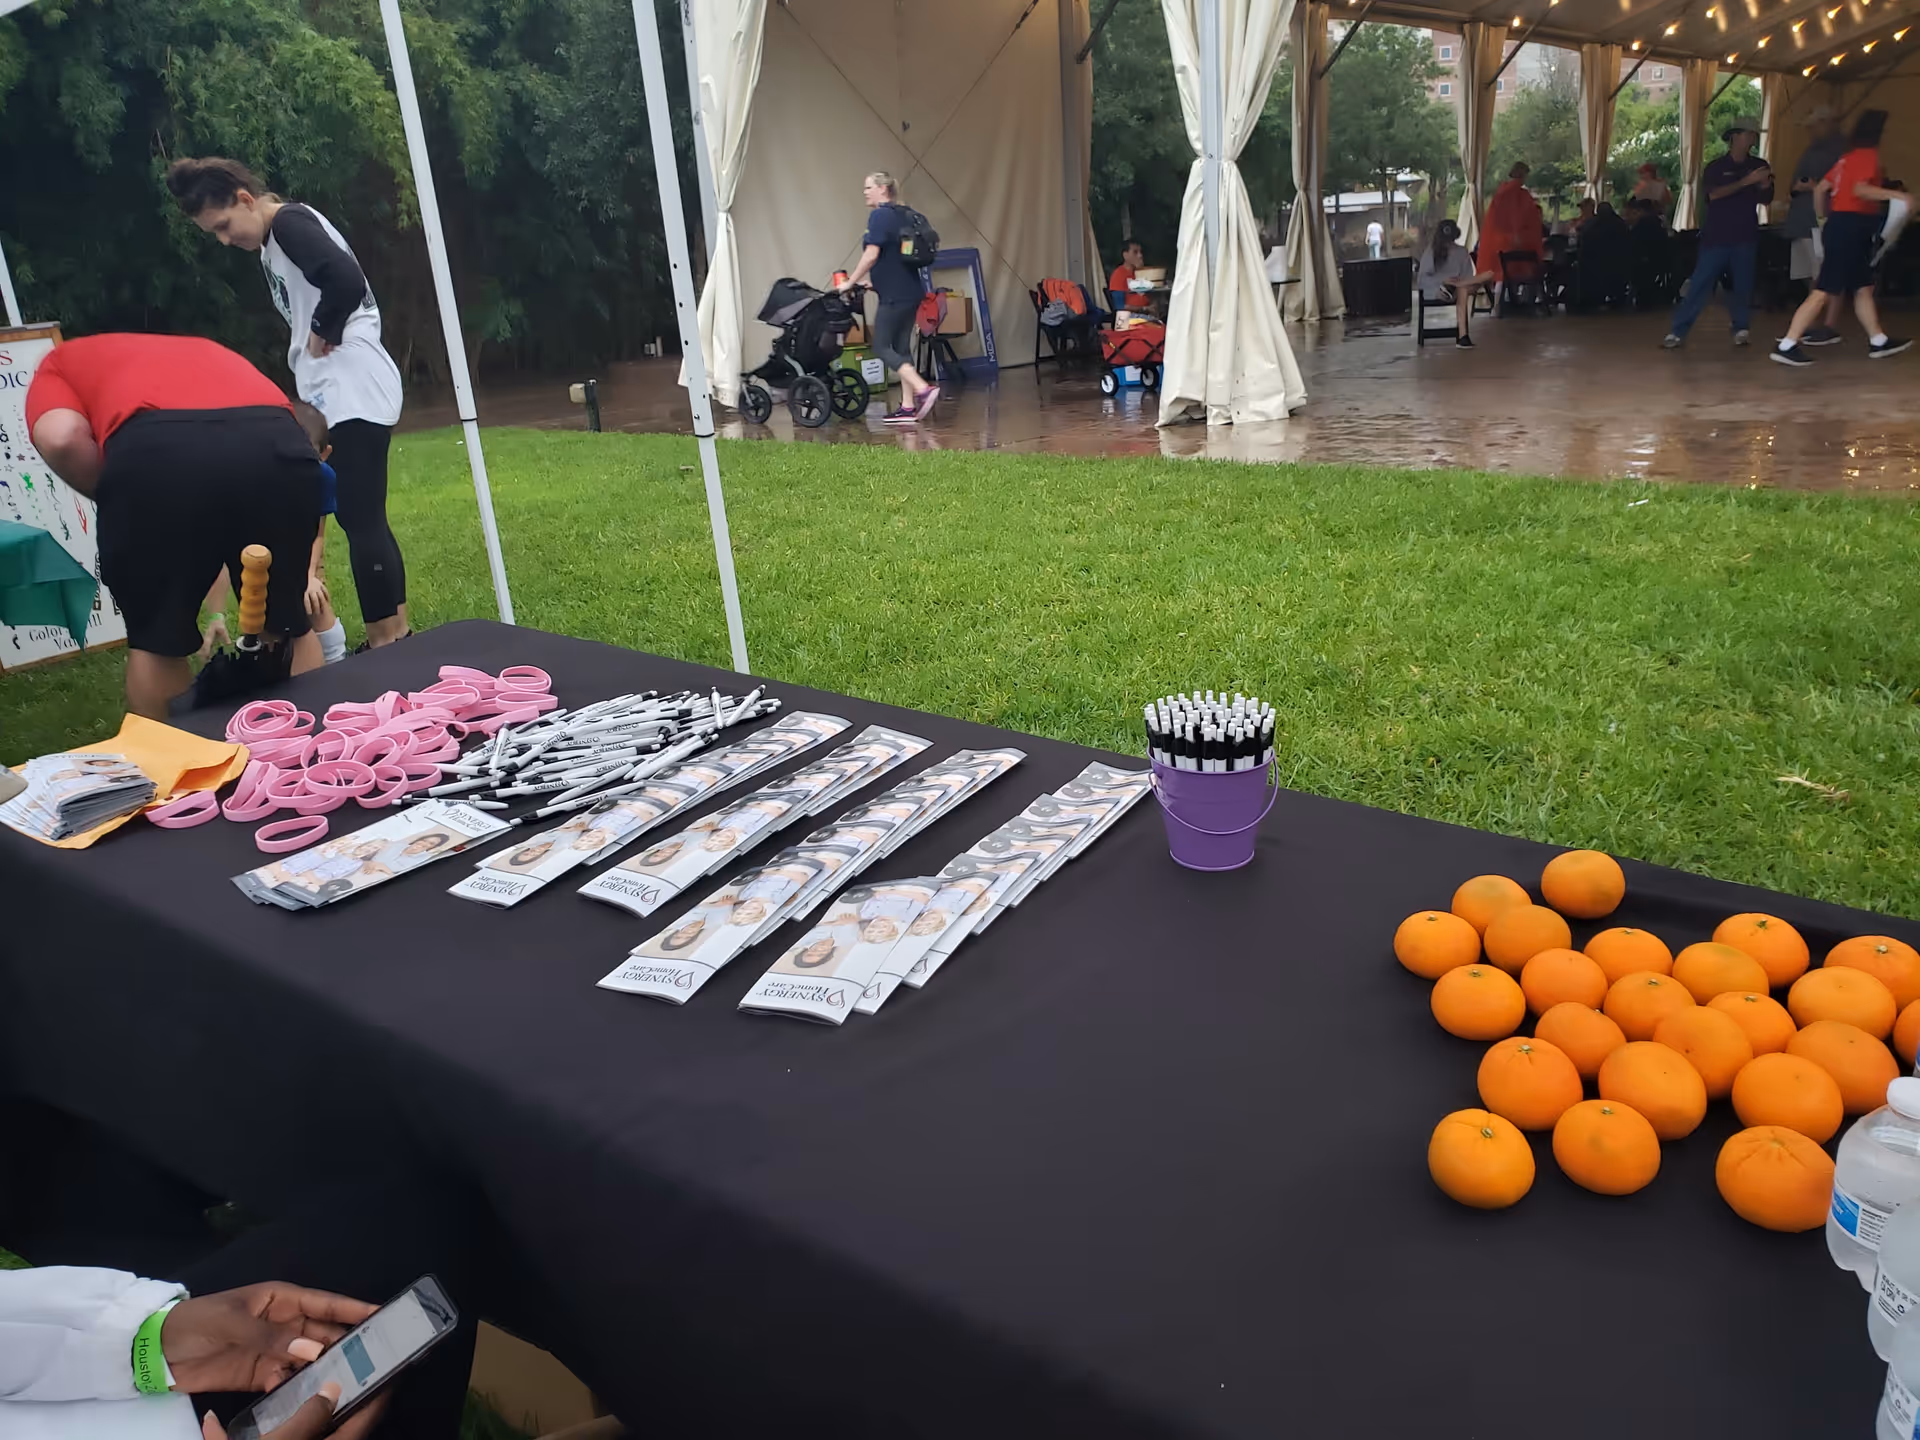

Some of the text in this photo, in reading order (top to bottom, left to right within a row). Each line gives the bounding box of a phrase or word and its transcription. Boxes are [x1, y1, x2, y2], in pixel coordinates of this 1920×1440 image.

[469, 881, 510, 894] SYNERGY
[598, 880, 642, 898] SYNERGY
[607, 875, 650, 892] HomeCare
[619, 971, 676, 984] SYNERGY
[629, 965, 682, 977] HomeCare
[767, 982, 830, 995] HomeCare
[760, 988, 826, 1003] SYNERGY
